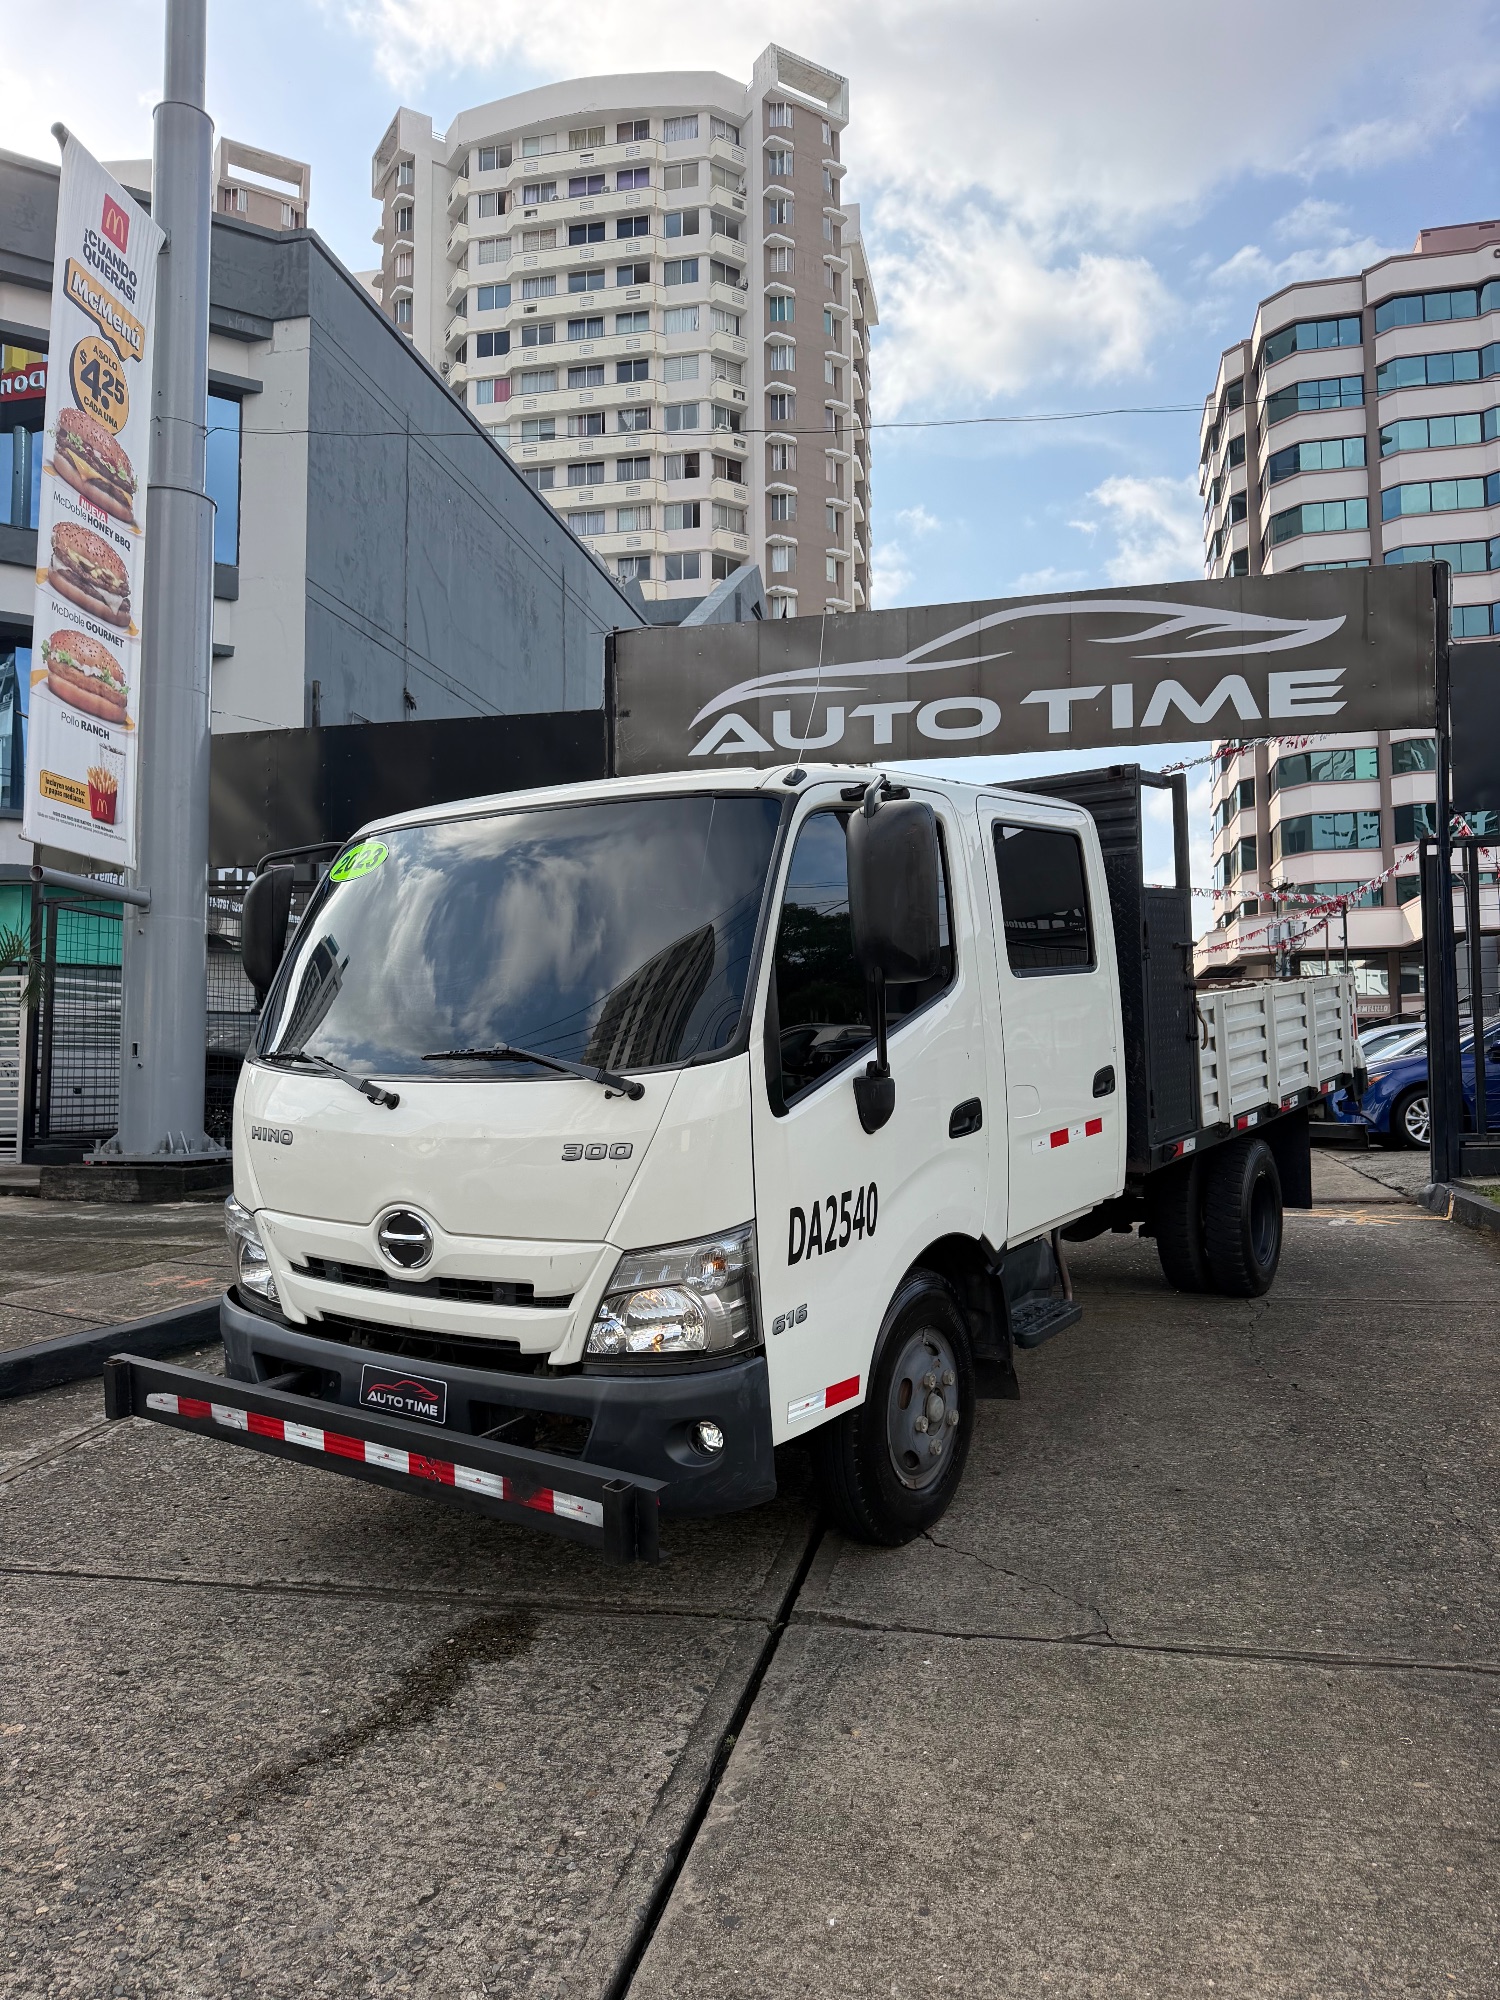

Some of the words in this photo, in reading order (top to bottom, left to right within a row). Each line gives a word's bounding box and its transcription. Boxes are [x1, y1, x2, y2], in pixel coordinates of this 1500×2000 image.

[83, 243, 136, 304] QUIERAS!
[84, 228, 137, 287] ¡CUANDO
[71, 271, 140, 351] McMenú
[99, 350, 117, 371] SOLO
[84, 396, 103, 418] CADA
[103, 414, 118, 430] UNA
[54, 491, 87, 520] McDoble
[87, 515, 114, 539] HONEY
[115, 532, 131, 552] BBQ
[81, 498, 107, 522] NUEVA
[51, 601, 85, 627] McDoble
[86, 621, 124, 648] GOURMET
[61, 711, 80, 728] Pollo
[81, 720, 110, 740] RANCH
[688, 696, 1001, 757] AUTO
[1020, 667, 1347, 734] TIME
[49, 788, 62, 797] papas
[333, 848, 383, 876] 2023
[252, 1126, 293, 1145] HINO
[561, 1142, 633, 1161] 300
[787, 1182, 878, 1266] DA2540
[772, 1303, 808, 1336] 616
[367, 1391, 403, 1407] AUTO
[405, 1399, 438, 1416] TIME
